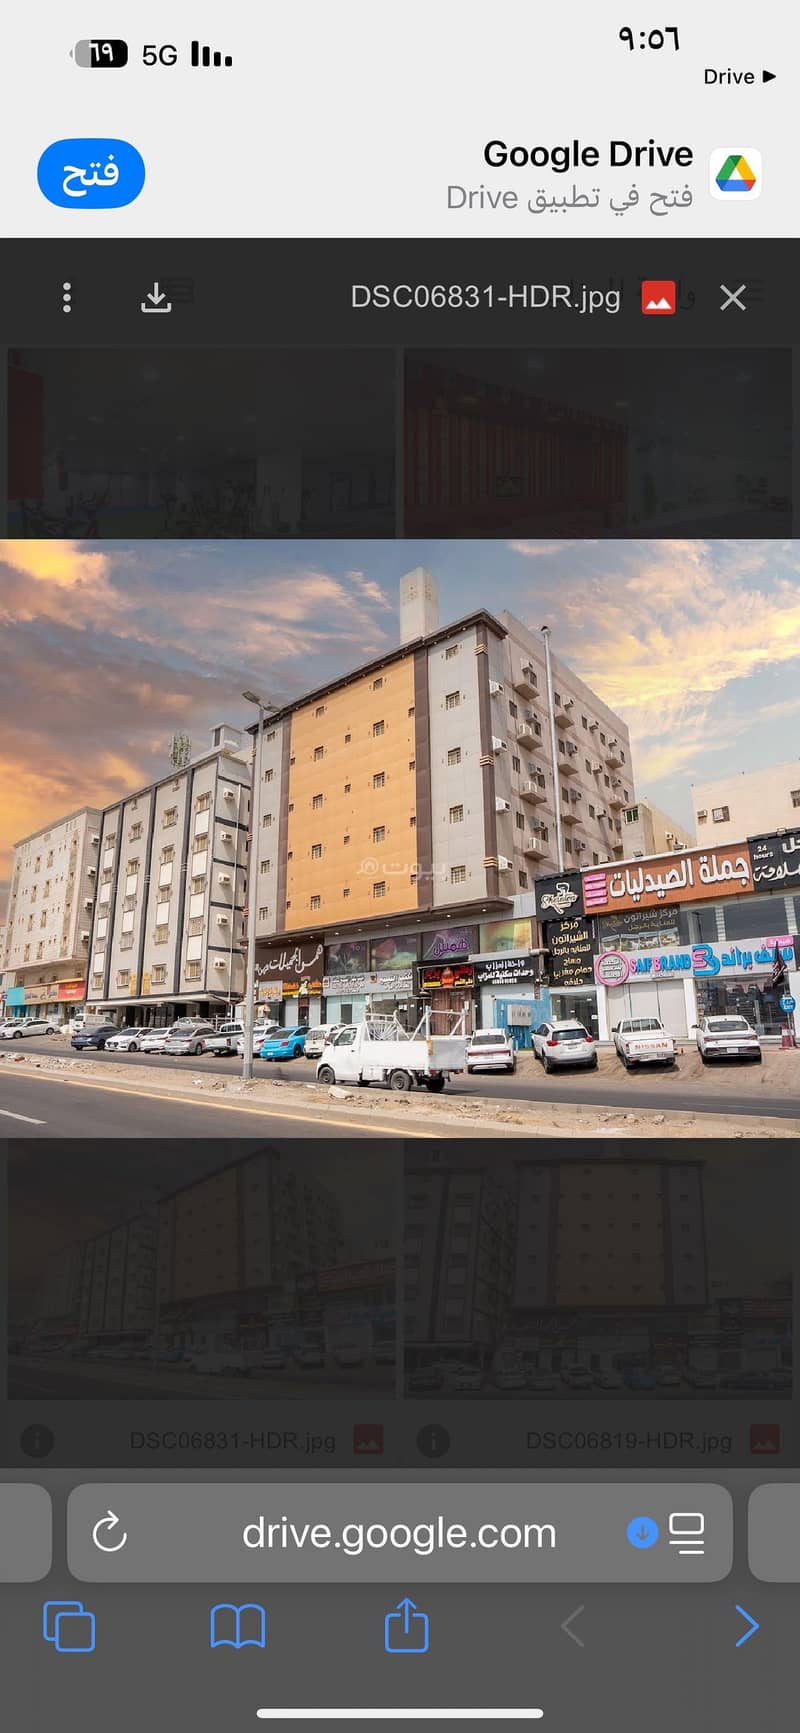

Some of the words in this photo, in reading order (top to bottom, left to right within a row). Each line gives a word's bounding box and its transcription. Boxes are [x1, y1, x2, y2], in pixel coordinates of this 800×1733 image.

[619, 26, 680, 52] ٩:٥٦
[142, 44, 178, 67] 5G
[704, 68, 756, 85] Drive
[484, 140, 600, 173] Google
[609, 139, 694, 168] Drive
[62, 154, 120, 198] فتح
[447, 183, 519, 210] Drive
[528, 184, 601, 215] تطبيق
[609, 184, 640, 217] في
[649, 184, 693, 217] فتح
[351, 284, 621, 314] DSC06831-HDR.jpg
[757, 844, 768, 853] 24
[609, 857, 694, 902] الصيدليات
[700, 855, 750, 887] جملة
[560, 920, 579, 931] مركز
[623, 909, 658, 924] شيراتون
[659, 908, 678, 920] مركز
[551, 931, 589, 945] الشيراتون
[630, 956, 653, 974] SAIF
[652, 953, 691, 972] BRAND
[721, 946, 753, 970] براند
[513, 969, 535, 977] وحدات
[574, 966, 593, 976] حمام
[634, 1042, 668, 1051] NISSAN
[130, 1431, 336, 1454] DSC06831-HDR.jpg
[527, 1431, 732, 1454] DSC06819-HDR.jpg
[243, 1515, 556, 1556] drive.google.com
